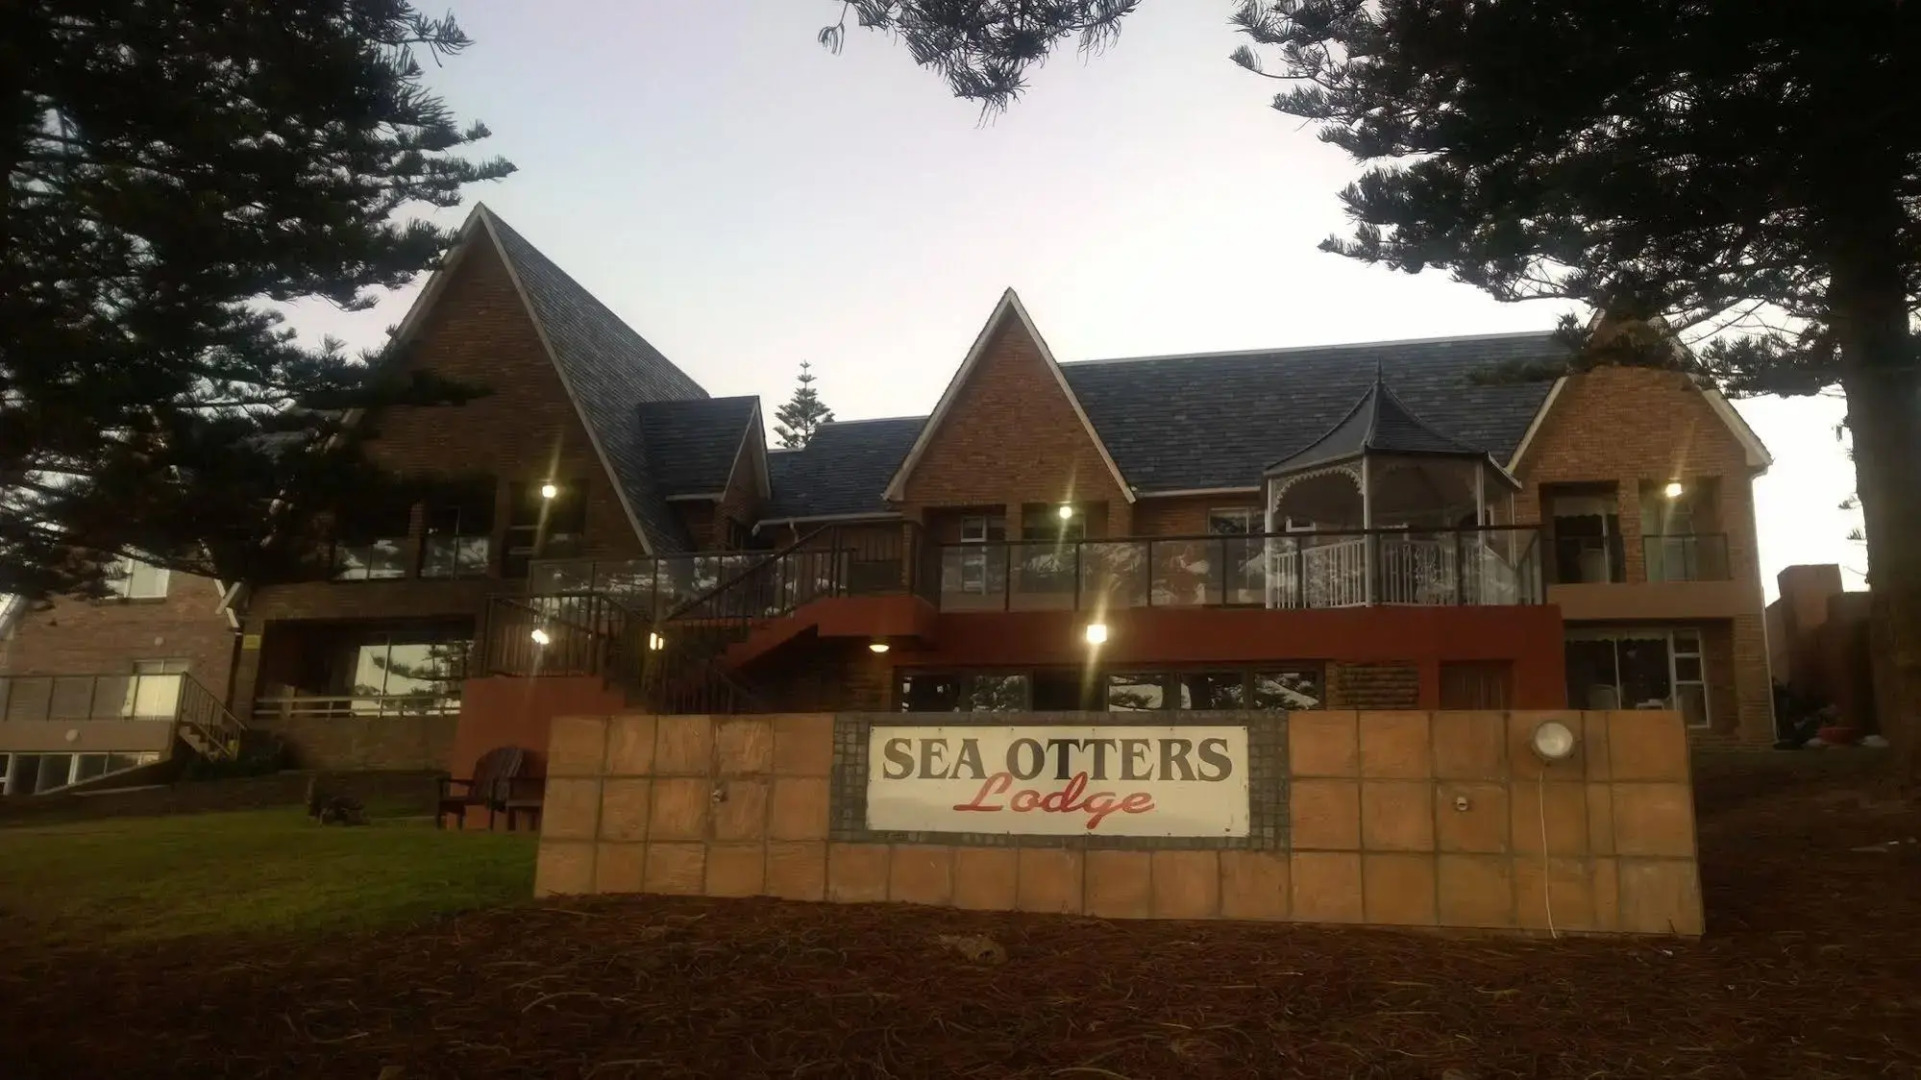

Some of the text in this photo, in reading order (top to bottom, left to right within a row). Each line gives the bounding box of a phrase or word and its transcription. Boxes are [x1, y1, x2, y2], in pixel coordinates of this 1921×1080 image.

[882, 737, 1232, 782] SEA OTTERS
[953, 771, 1155, 829] Lodge
